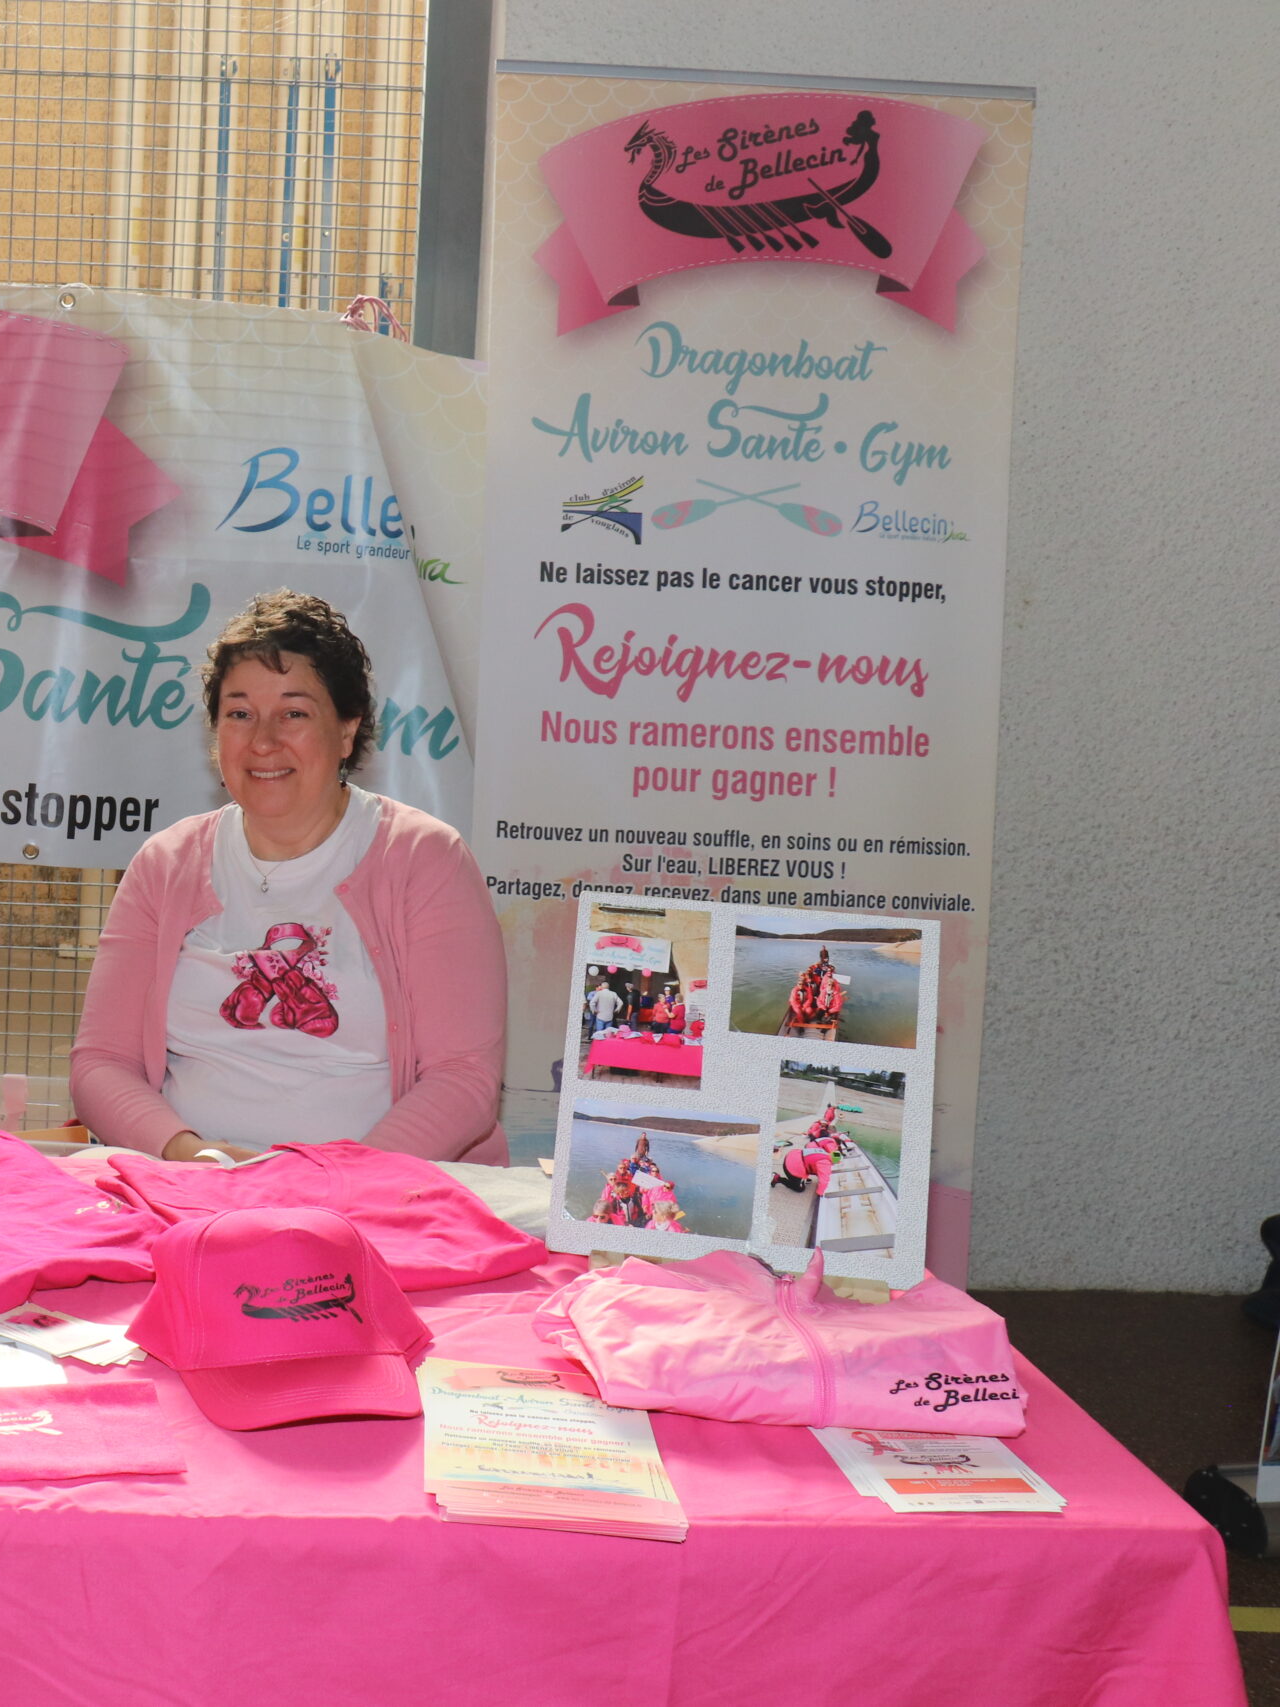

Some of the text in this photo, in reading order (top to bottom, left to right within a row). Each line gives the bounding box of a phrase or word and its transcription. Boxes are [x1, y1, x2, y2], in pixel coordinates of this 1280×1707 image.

[675, 117, 820, 173] Les Sirènes
[705, 146, 847, 199] de Bellecin
[633, 321, 888, 395] Dragonboat
[531, 393, 951, 486] Aviron Santé Gym
[214, 447, 405, 539] Belle
[569, 476, 636, 502] club d'aviron
[591, 518, 629, 538] vouglans
[850, 500, 948, 535] Bellecin
[297, 536, 412, 560] Le sport grandeur
[539, 561, 946, 603] Ne laissez pas le cancer vous stopper,
[533, 602, 928, 702] Rejoignez-nous
[540, 710, 930, 757] Nous ramerons ensemble
[632, 765, 837, 802] pour gagner !
[0, 789, 160, 842] stopper
[496, 820, 971, 856] Retrouvez un nouveau souffle, en soins ou en rémission.
[622, 854, 846, 879] Sur l'eau, LIBEREZ VOUS !
[486, 875, 566, 900] Partagez,
[721, 884, 762, 905] dans
[767, 889, 797, 906] une
[803, 888, 886, 910] ambiance
[891, 891, 975, 912] conviviale.
[289, 1283, 346, 1304] Bellecin
[889, 1373, 1009, 1394] Les Sirènes
[914, 1388, 1020, 1412] de Belleci
